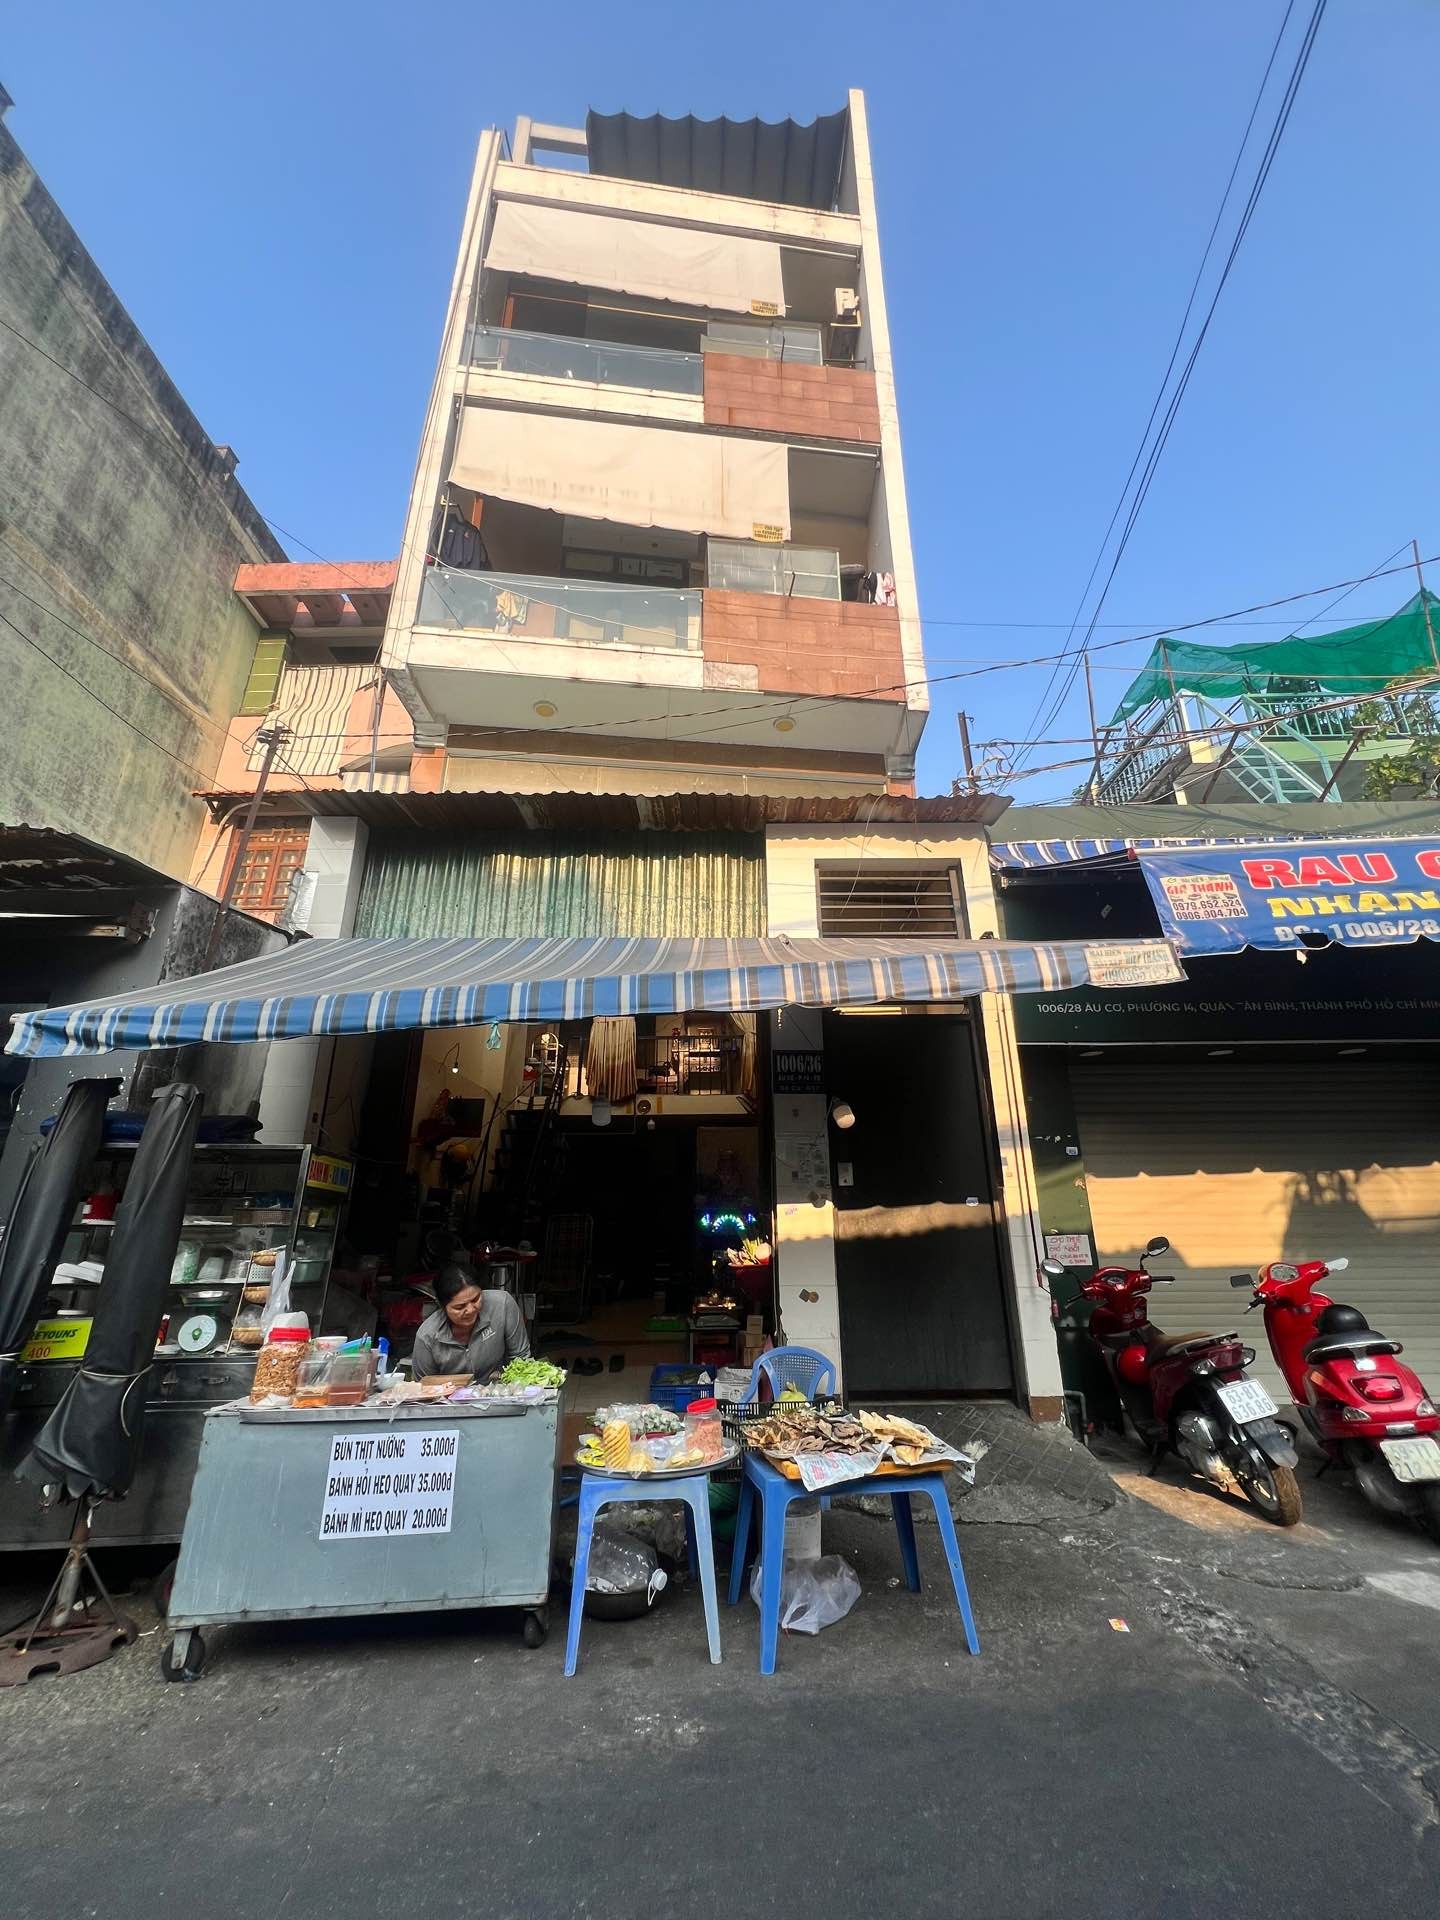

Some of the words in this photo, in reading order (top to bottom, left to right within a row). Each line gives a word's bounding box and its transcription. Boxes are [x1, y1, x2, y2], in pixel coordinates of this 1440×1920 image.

[1240, 852, 1398, 890] RAU
[1037, 1003, 1082, 1014] 1006/28
[776, 1055, 822, 1073] 1006/36
[333, 1437, 353, 1461] BÚN
[355, 1440, 375, 1464] THỊT
[376, 1435, 405, 1459] NƯỚNG
[421, 1437, 456, 1457] 35.000đ
[328, 1472, 353, 1497] BÁNH
[355, 1468, 371, 1496] HỎI
[373, 1475, 391, 1495] HEO
[393, 1473, 416, 1498] QUAY
[418, 1472, 452, 1492] 35.000đ
[323, 1508, 349, 1534] BÁNH
[350, 1507, 363, 1532] MÌ
[364, 1511, 382, 1532] HEO
[384, 1510, 408, 1534] QUAY
[411, 1508, 448, 1529] 20.000đ
